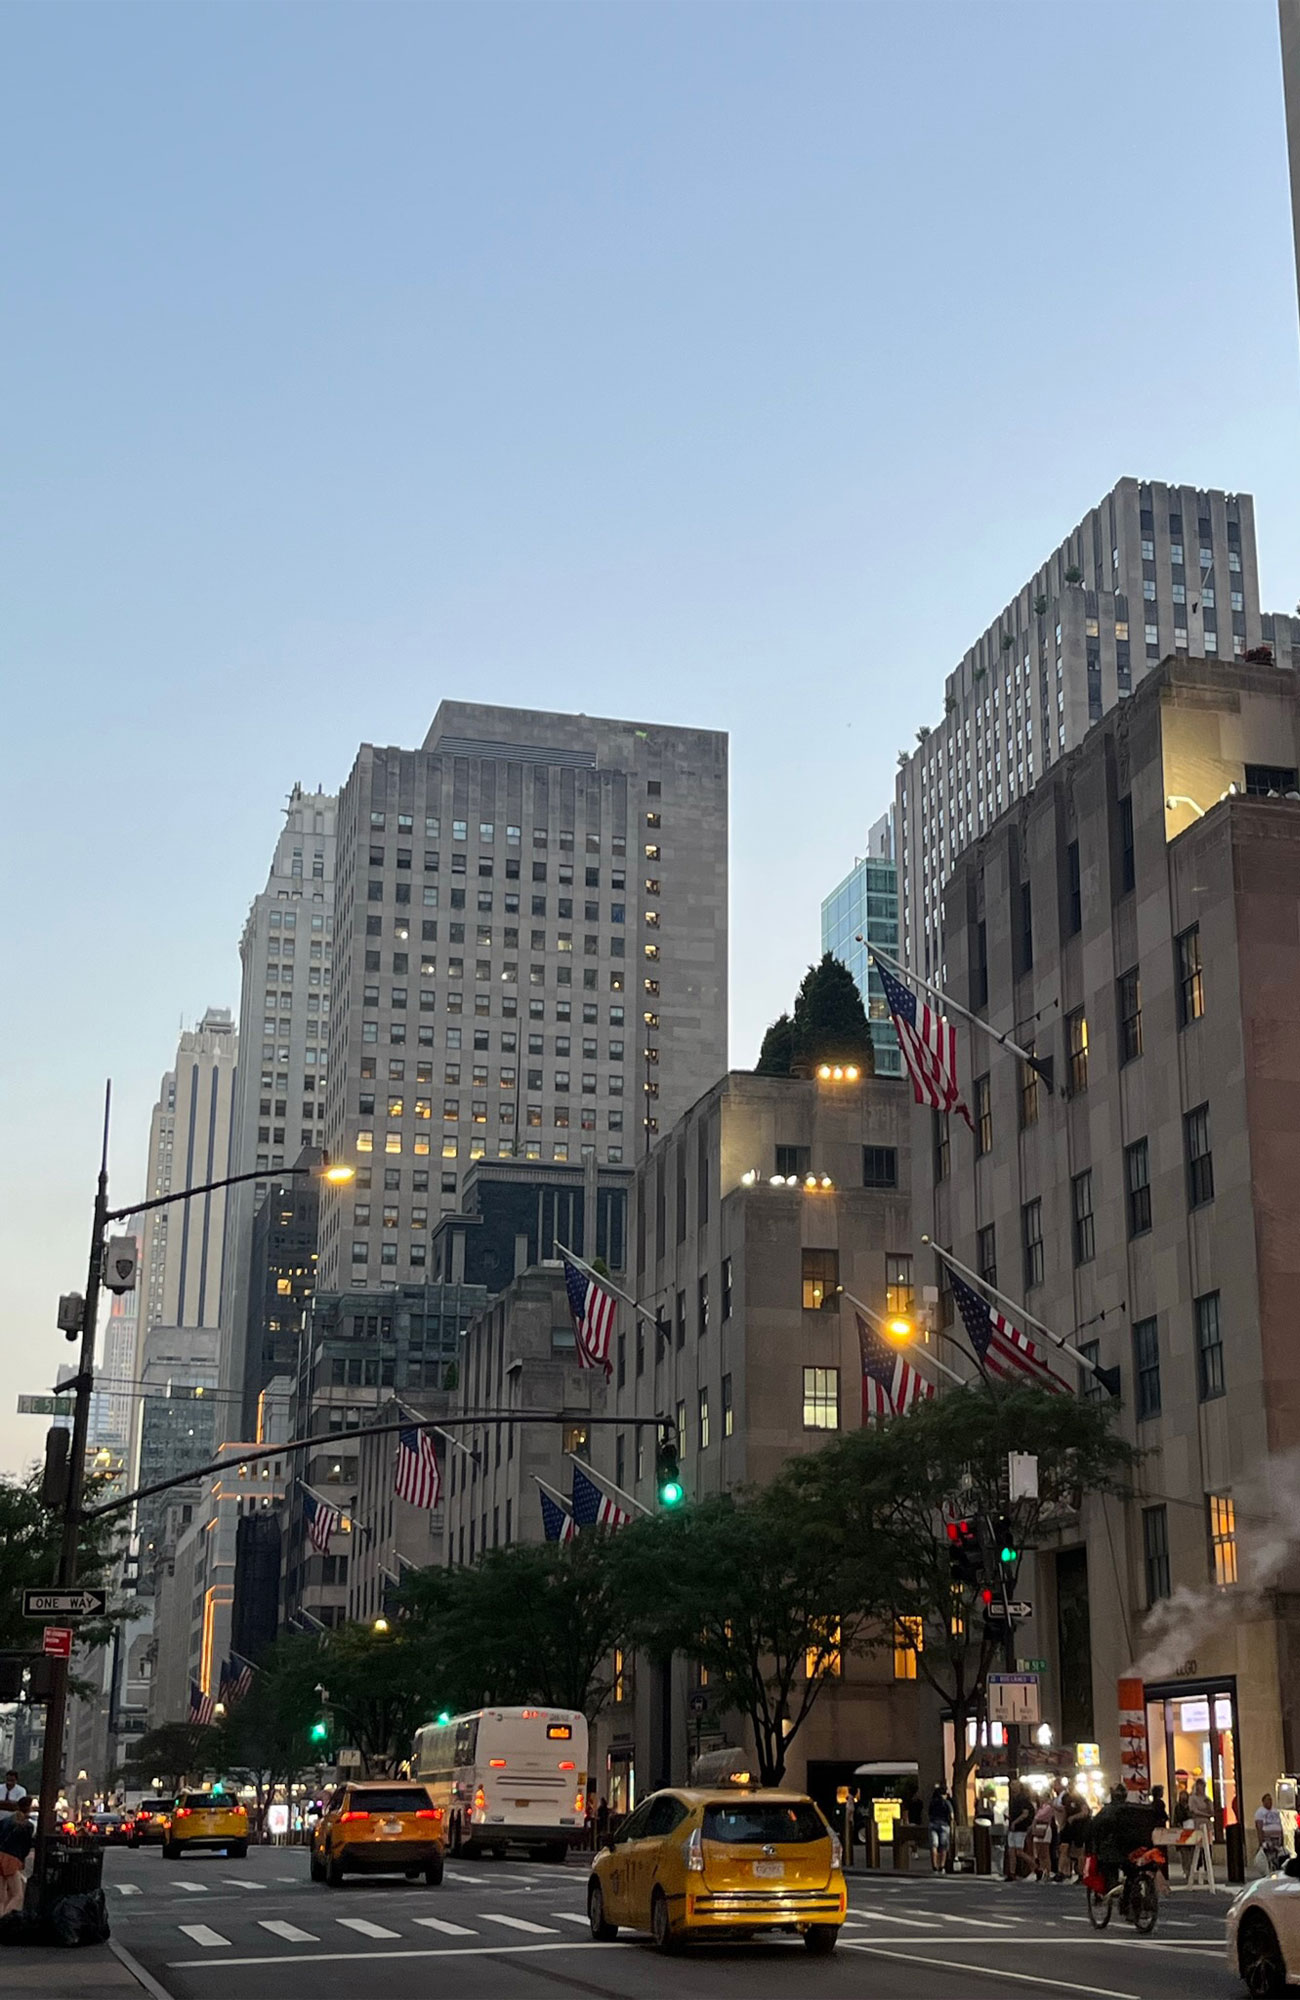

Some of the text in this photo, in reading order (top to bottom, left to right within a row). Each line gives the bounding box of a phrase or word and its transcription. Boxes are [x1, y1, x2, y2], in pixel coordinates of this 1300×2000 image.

[44, 1398, 56, 1413] 51
[36, 1598, 94, 1609] ONE WAY
